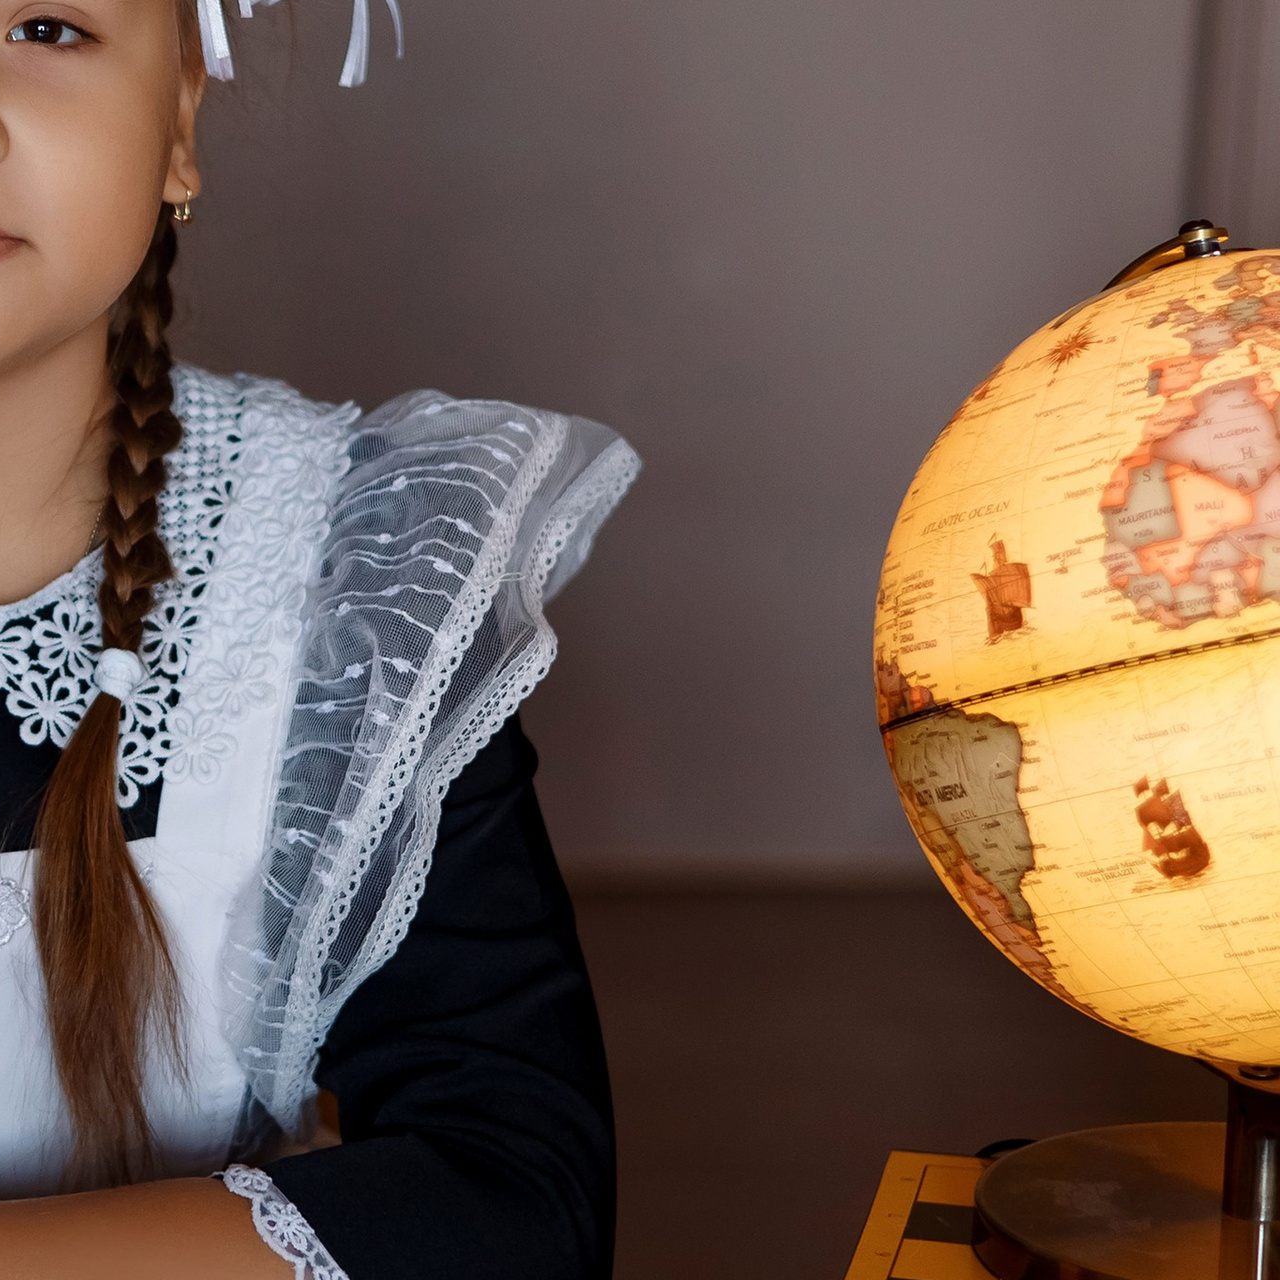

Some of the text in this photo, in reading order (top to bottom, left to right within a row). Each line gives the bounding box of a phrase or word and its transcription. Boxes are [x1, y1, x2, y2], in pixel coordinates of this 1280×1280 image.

[1212, 425, 1261, 441] ALGERIA
[1194, 500, 1225, 513] MALI
[921, 499, 1011, 536] ATLANTIC OCEAN
[934, 782, 968, 803] AMERICA
